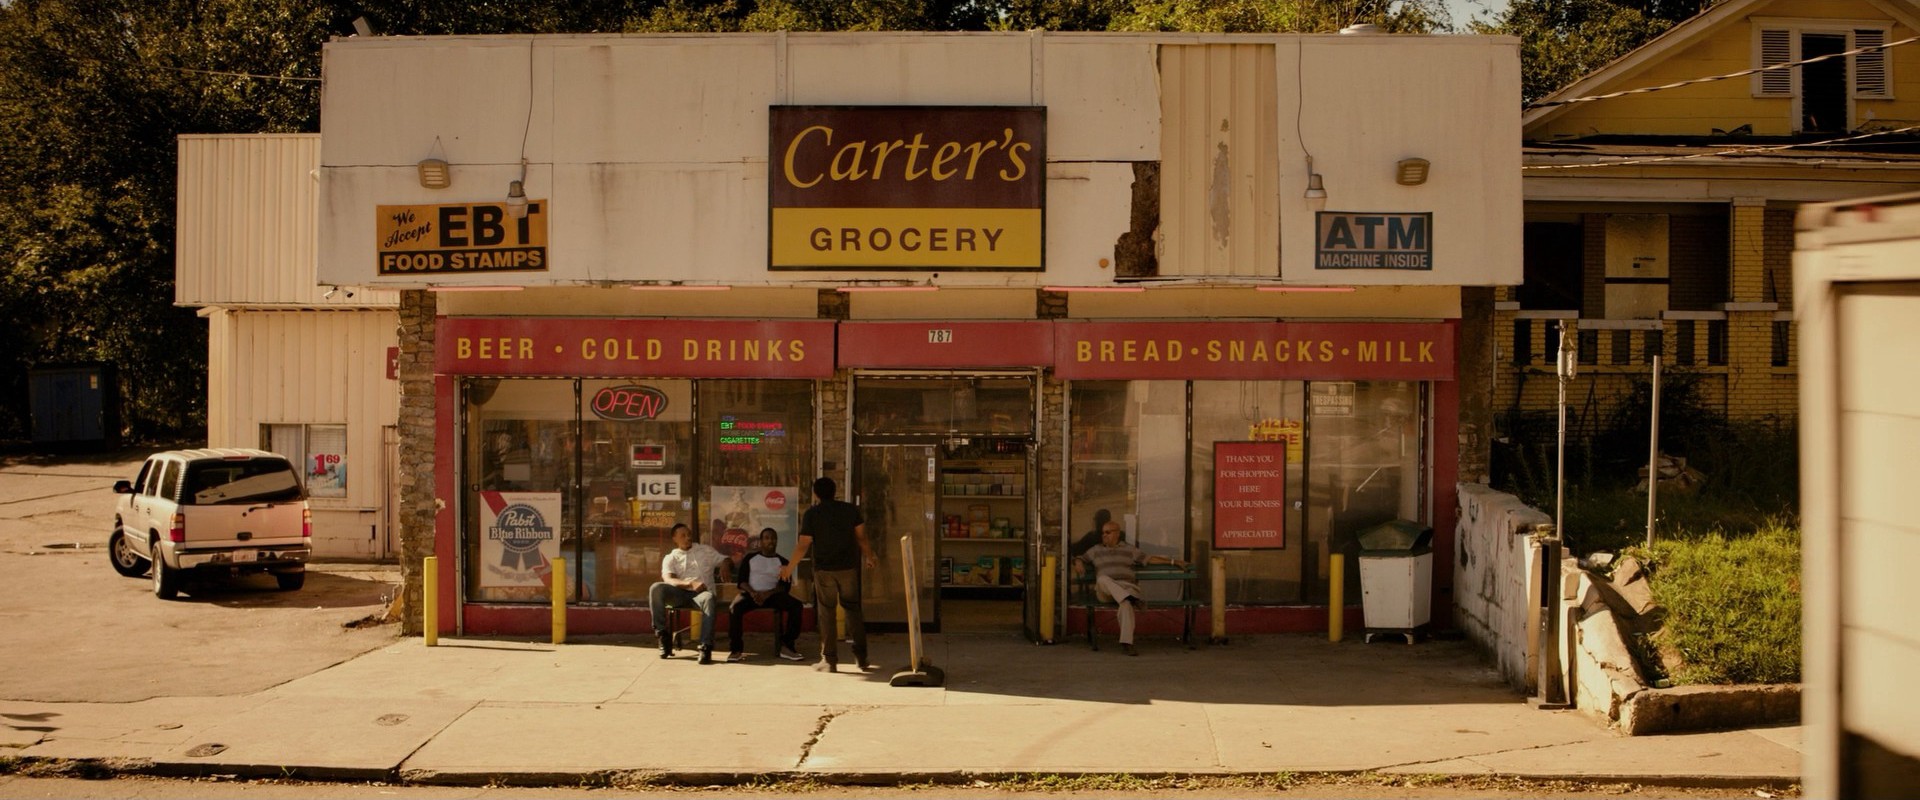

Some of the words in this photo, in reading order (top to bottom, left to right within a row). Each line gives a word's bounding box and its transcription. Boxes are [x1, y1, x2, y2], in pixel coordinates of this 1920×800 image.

[784, 125, 1031, 188] Carter's
[393, 208, 415, 226] We
[439, 204, 540, 247] EBT
[384, 221, 432, 248] Accept
[810, 227, 1004, 251] GROCERY
[1324, 216, 1425, 249] ATM
[383, 254, 444, 271] FOOD
[450, 250, 542, 269] STAMPS
[1320, 253, 1380, 268] MACHINE
[1384, 254, 1428, 268] INSIDE
[930, 330, 951, 342] 787
[457, 338, 534, 360] BEER
[582, 338, 662, 361] COLD
[683, 339, 806, 362] DRINKS
[1077, 340, 1183, 362] BREAD
[1207, 340, 1334, 362] SNACKS
[1358, 341, 1434, 362] MILK
[595, 388, 660, 418] OPEN
[1312, 395, 1352, 406] TRESPASSING
[1225, 455, 1255, 463] THANK
[1256, 455, 1274, 463] YOU
[1220, 470, 1237, 478] FOR
[1238, 470, 1279, 478] SHOPPING
[641, 482, 677, 495] ICE
[1239, 485, 1261, 493] HERE
[1219, 500, 1242, 508] YOUR
[1243, 500, 1280, 508] BUSINESS
[505, 510, 536, 527] Pabst
[490, 527, 514, 540] Blue
[515, 527, 551, 539] Ribbon
[1222, 530, 1277, 538] APPRECIATED
